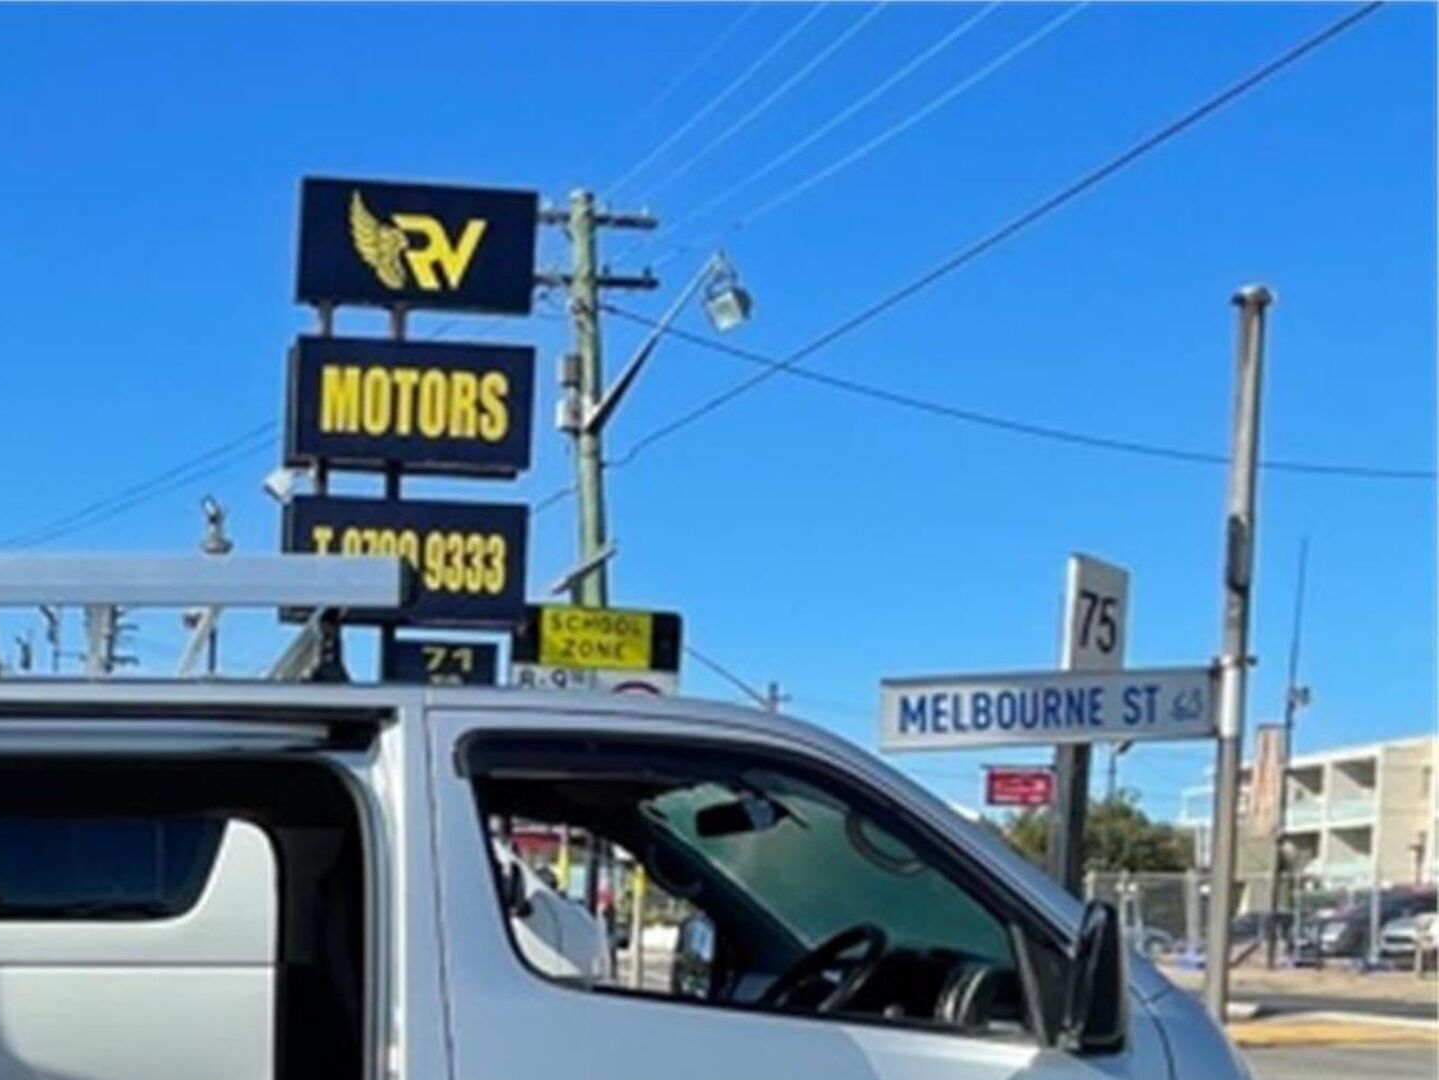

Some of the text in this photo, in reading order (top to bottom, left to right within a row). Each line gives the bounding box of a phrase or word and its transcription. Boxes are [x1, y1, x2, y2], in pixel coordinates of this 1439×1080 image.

[392, 214, 487, 290] RV
[320, 365, 508, 441] MOTORS
[425, 531, 506, 594] 9333
[550, 614, 642, 637] SCHOOL
[562, 638, 627, 660] ZONE
[1079, 591, 1117, 654] 75
[421, 646, 474, 671] 71
[898, 688, 1104, 734] MELBOURNE
[1122, 686, 1162, 726] ST
